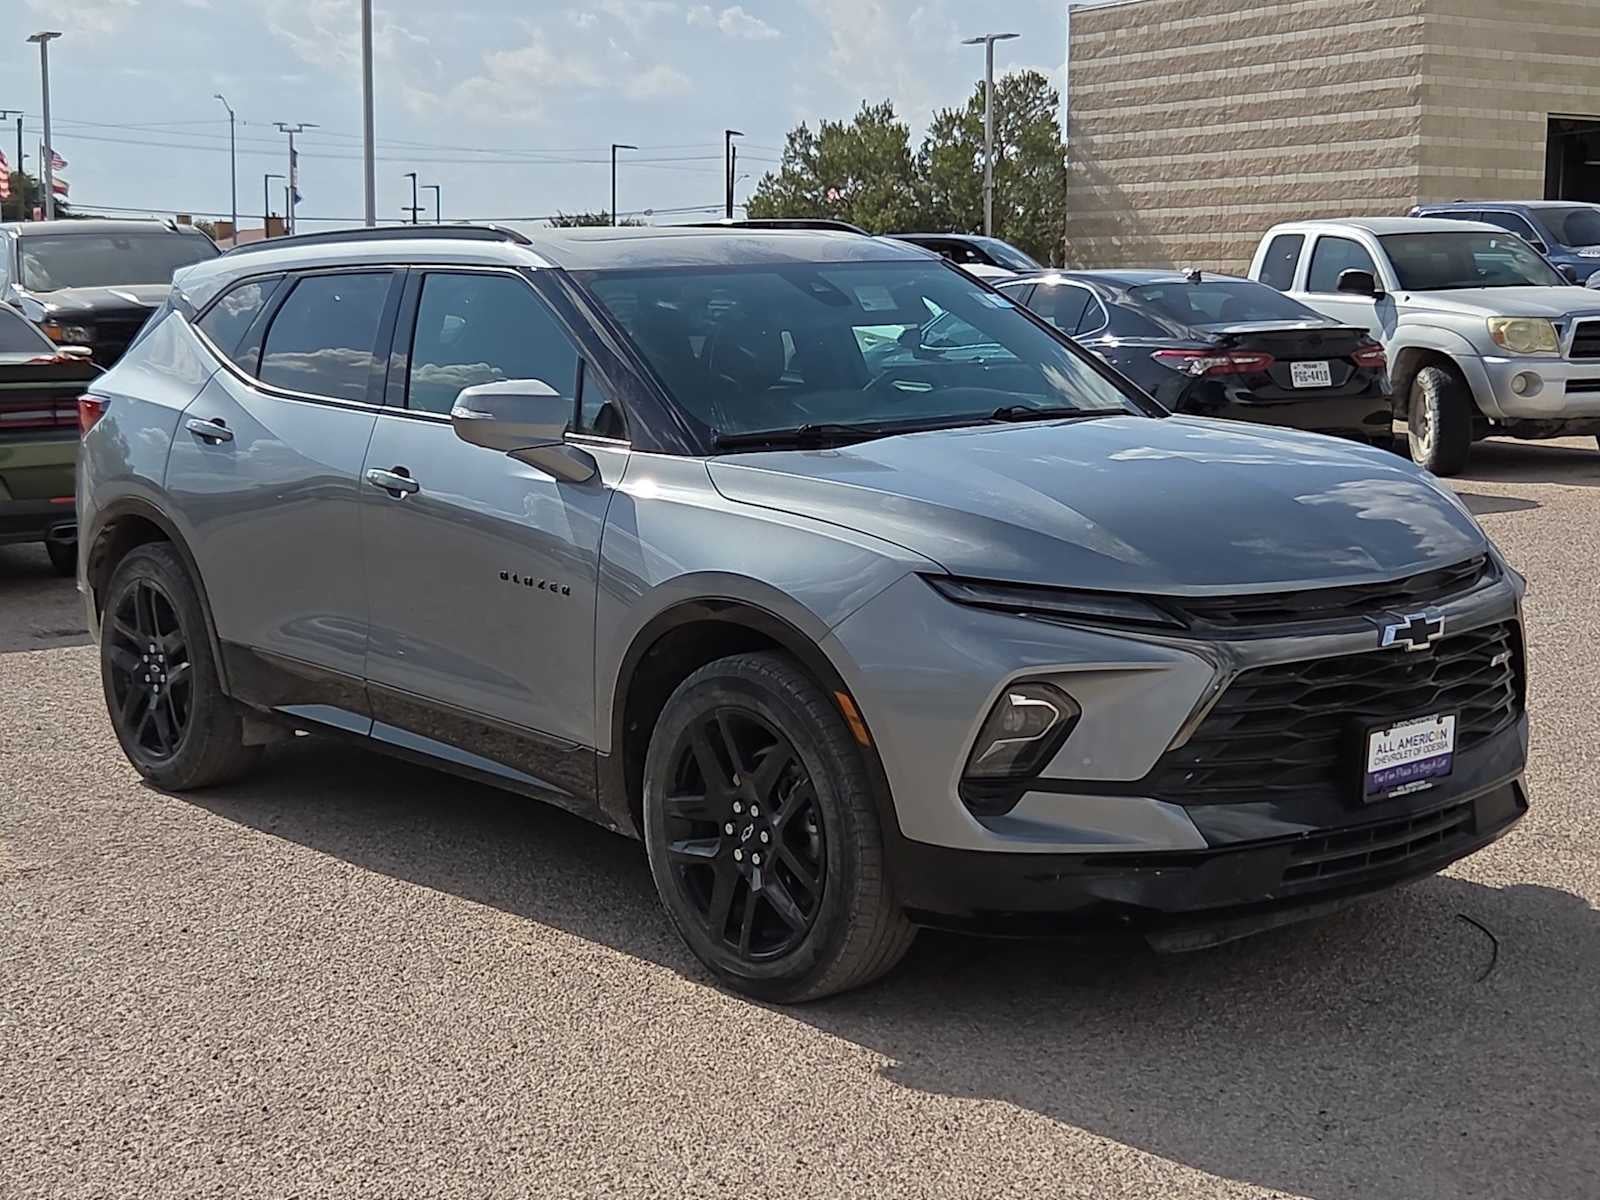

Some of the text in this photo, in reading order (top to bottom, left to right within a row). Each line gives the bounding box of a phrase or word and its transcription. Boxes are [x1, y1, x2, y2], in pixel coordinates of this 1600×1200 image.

[499, 571, 570, 596] BLAZER
[1375, 741, 1448, 766] CHEVROLET OF ODESSA
[1376, 742, 1395, 755] ALL
